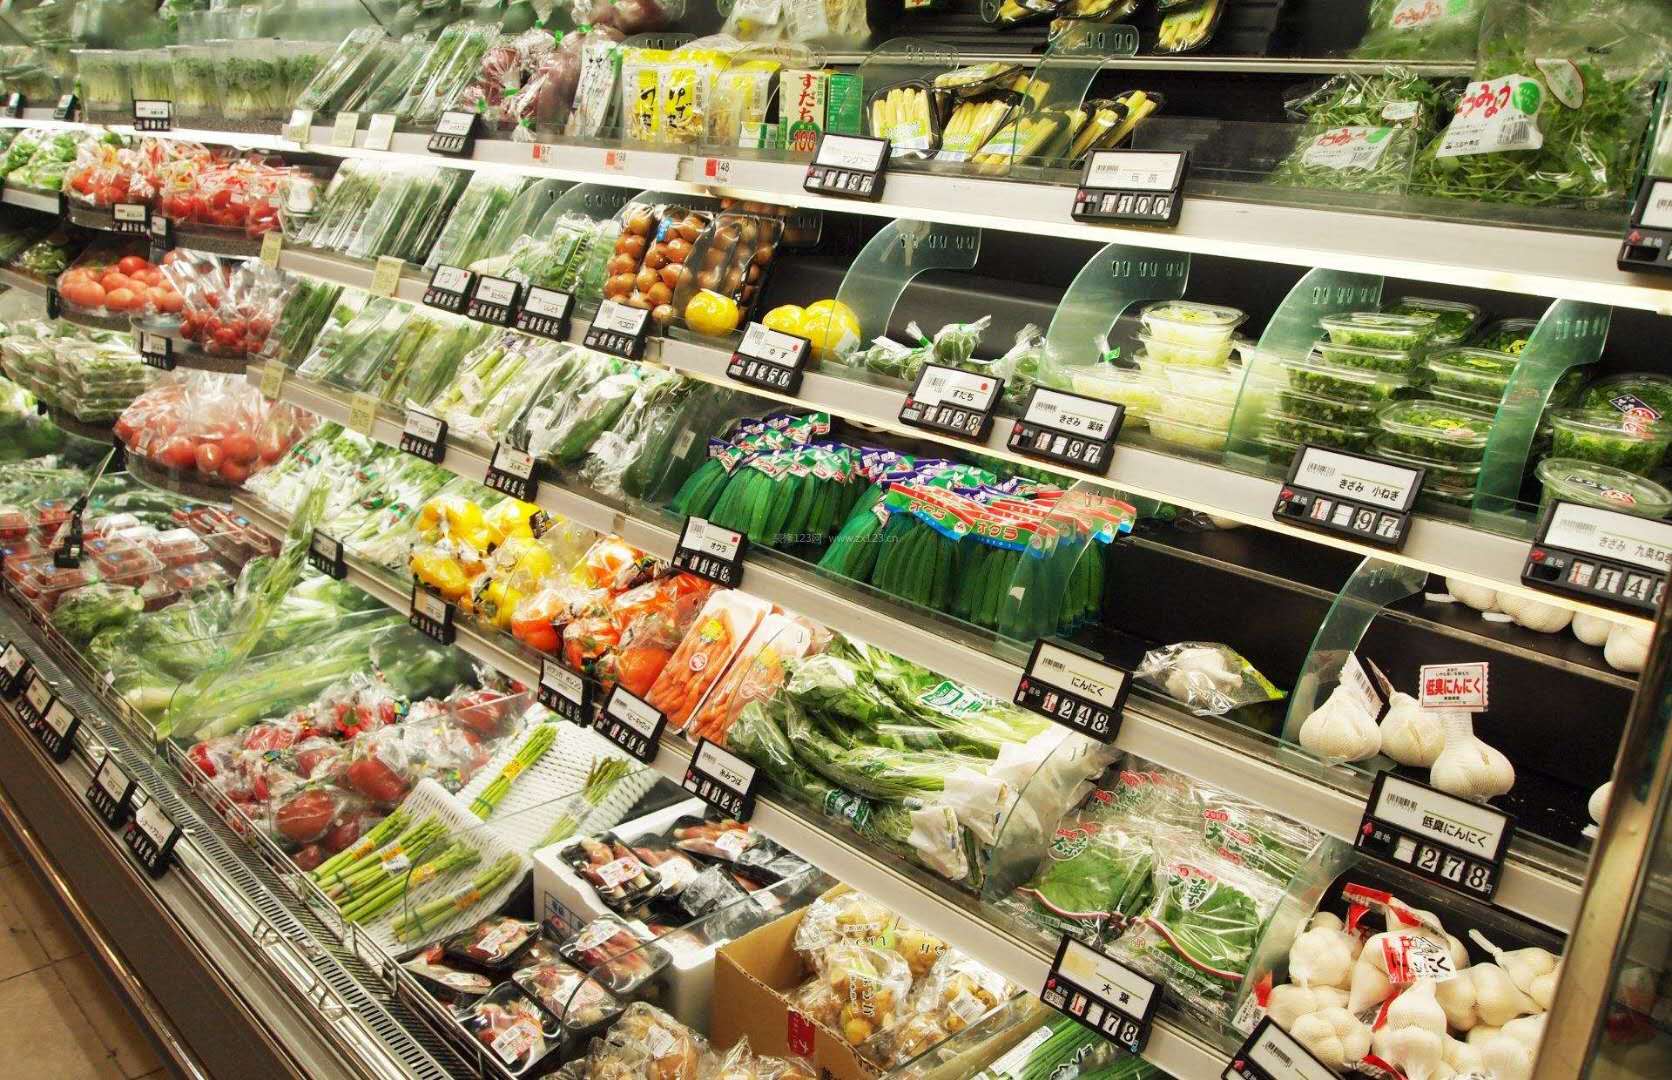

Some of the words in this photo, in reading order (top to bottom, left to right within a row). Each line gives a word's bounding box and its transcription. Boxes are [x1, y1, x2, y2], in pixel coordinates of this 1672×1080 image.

[799, 74, 819, 122] すだち
[952, 389, 974, 402] すだち
[1059, 415, 1081, 427] きざみ
[1338, 478, 1364, 493] きざみ
[1371, 486, 1400, 502] 小ねぎ
[976, 520, 1019, 539] オクラ
[710, 541, 728, 553] オクラ
[1599, 535, 1626, 551] きざみ
[1071, 676, 1105, 697] にんにく
[1425, 677, 1482, 696] 低臭にんにく
[1422, 815, 1486, 848] 低臭にんにく
[1421, 849, 1488, 889] 278
